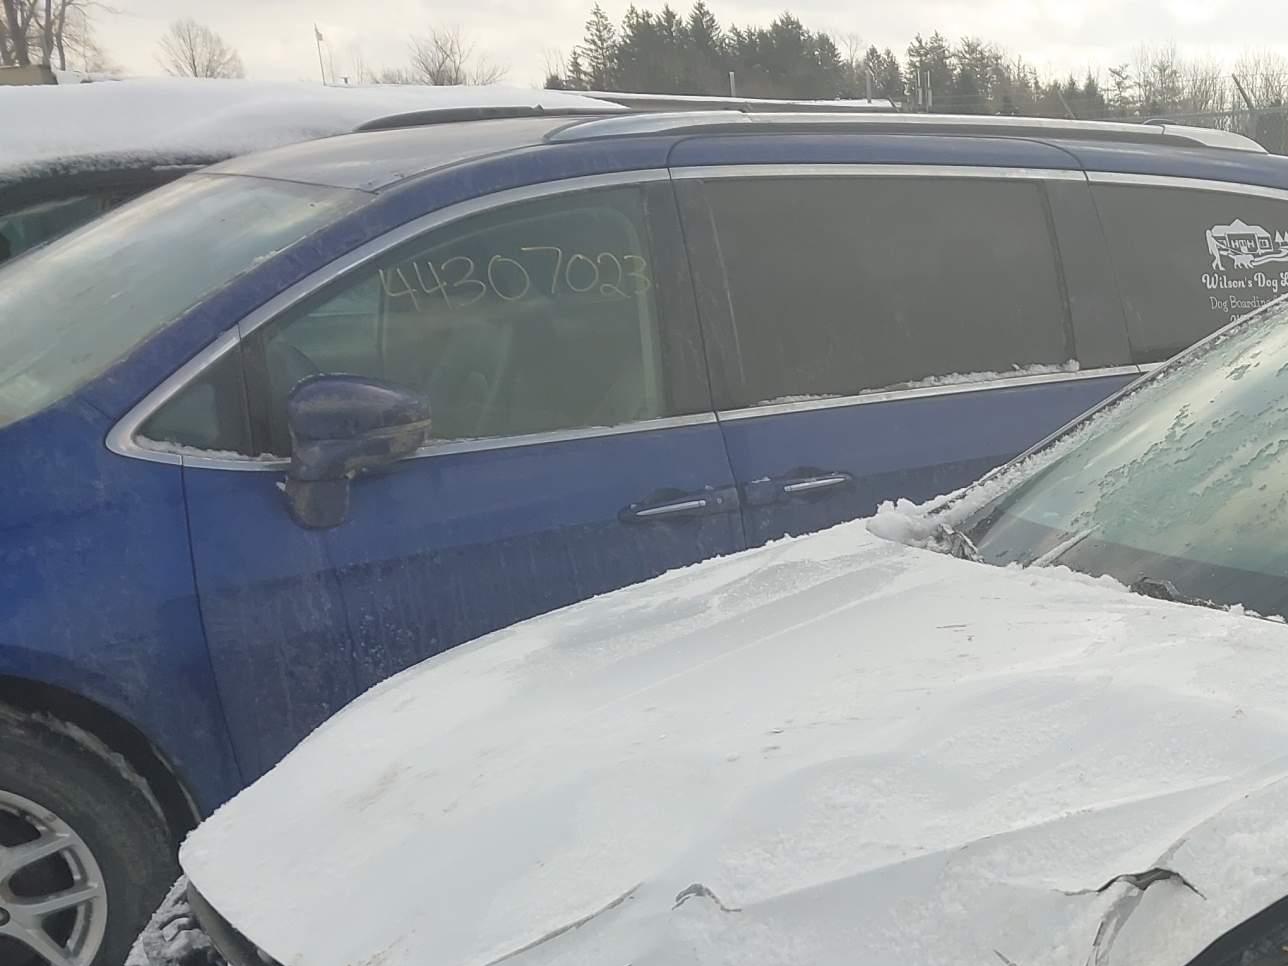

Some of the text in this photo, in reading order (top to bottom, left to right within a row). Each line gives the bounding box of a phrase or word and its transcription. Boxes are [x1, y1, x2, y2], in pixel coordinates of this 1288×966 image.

[379, 246, 650, 313] 44307023
[1202, 273, 1252, 289] Wilson's
[1254, 272, 1278, 292] Dog
[1210, 295, 1268, 312] Dog Boardin
